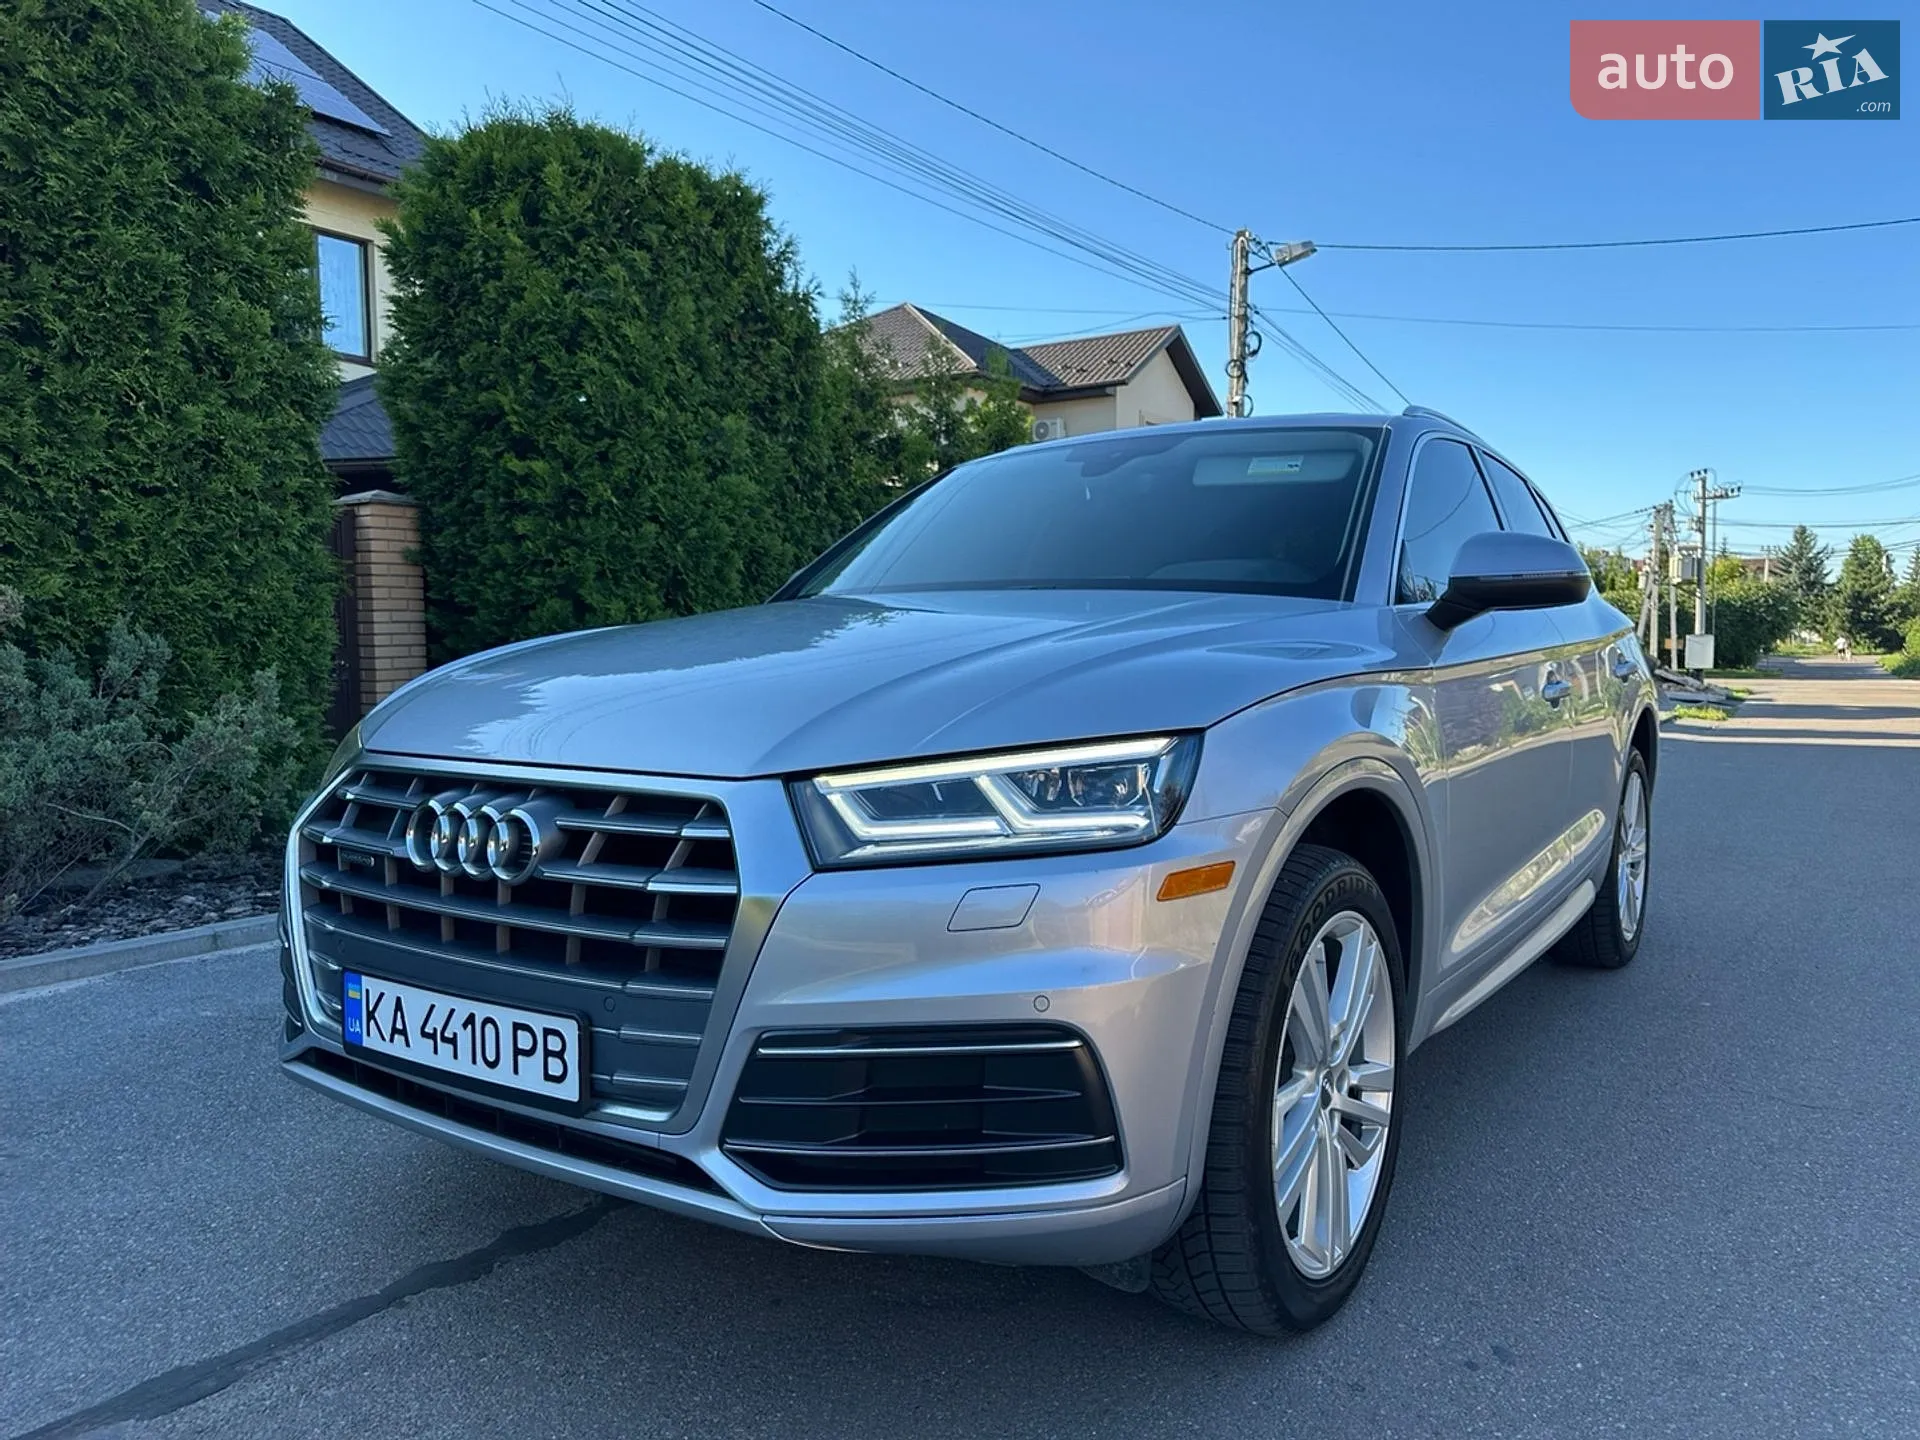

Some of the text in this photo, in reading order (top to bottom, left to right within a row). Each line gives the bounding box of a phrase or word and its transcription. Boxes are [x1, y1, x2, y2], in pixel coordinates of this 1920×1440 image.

[348, 1016, 361, 1034] UA
[365, 988, 568, 1084] KA 4410 PB
